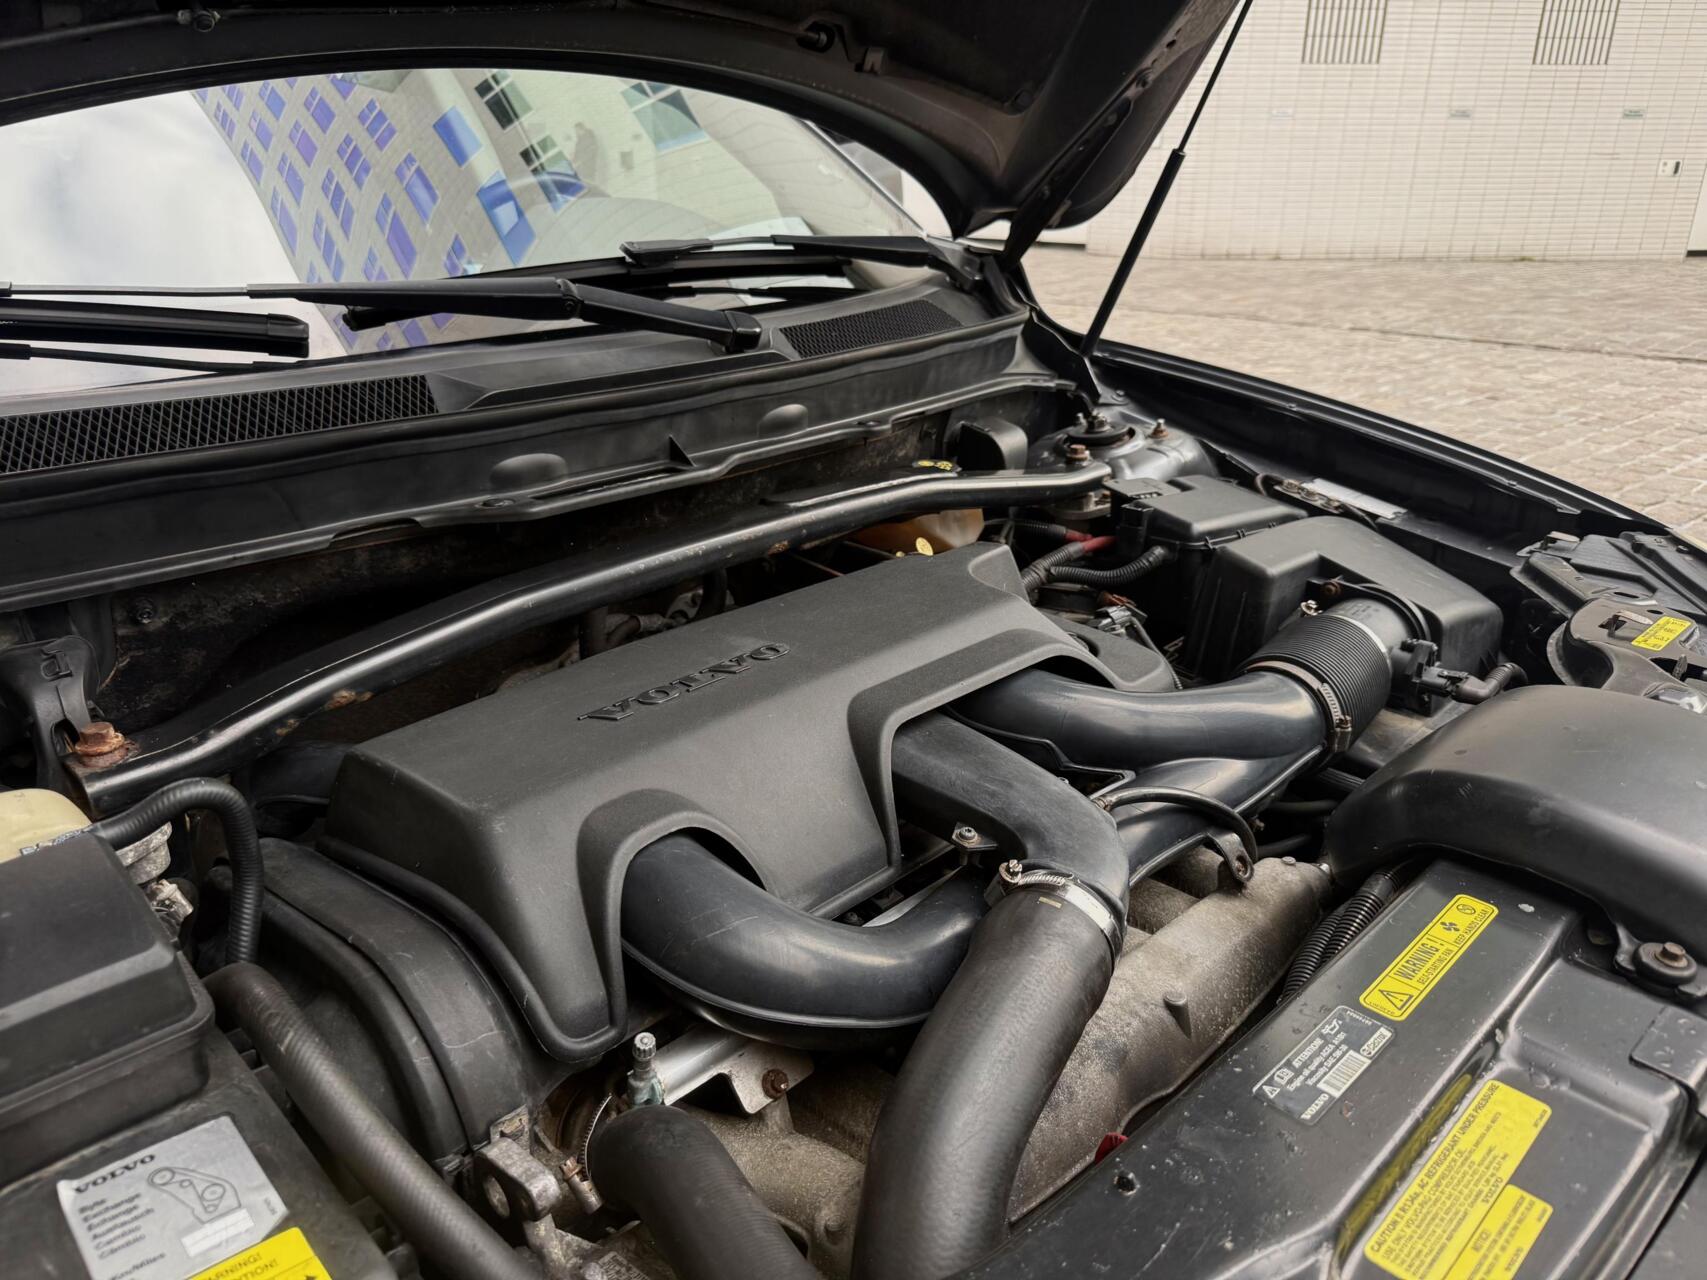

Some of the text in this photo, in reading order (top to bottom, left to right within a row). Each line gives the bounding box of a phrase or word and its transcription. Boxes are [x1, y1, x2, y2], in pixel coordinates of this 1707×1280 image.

[577, 642, 791, 721] VOLVO
[1452, 908, 1489, 944] KEEP HANDS CLEAR
[1394, 943, 1439, 981] WARNING
[1417, 947, 1453, 984] SELF-STARTING FAN
[1320, 1044, 1335, 1057] ACEA
[1301, 1093, 1330, 1121] VOLVO
[73, 1153, 156, 1194] VOLVO
[1370, 1219, 1399, 1252] CAUTION
[1415, 1178, 1429, 1190] AC
[1424, 1134, 1461, 1179] REFRIGERANT
[1456, 1113, 1477, 1135] UNDER
[1472, 1083, 1500, 1114] PRESSURE
[83, 1192, 141, 1223] Exchange
[92, 1207, 155, 1240] Austausch
